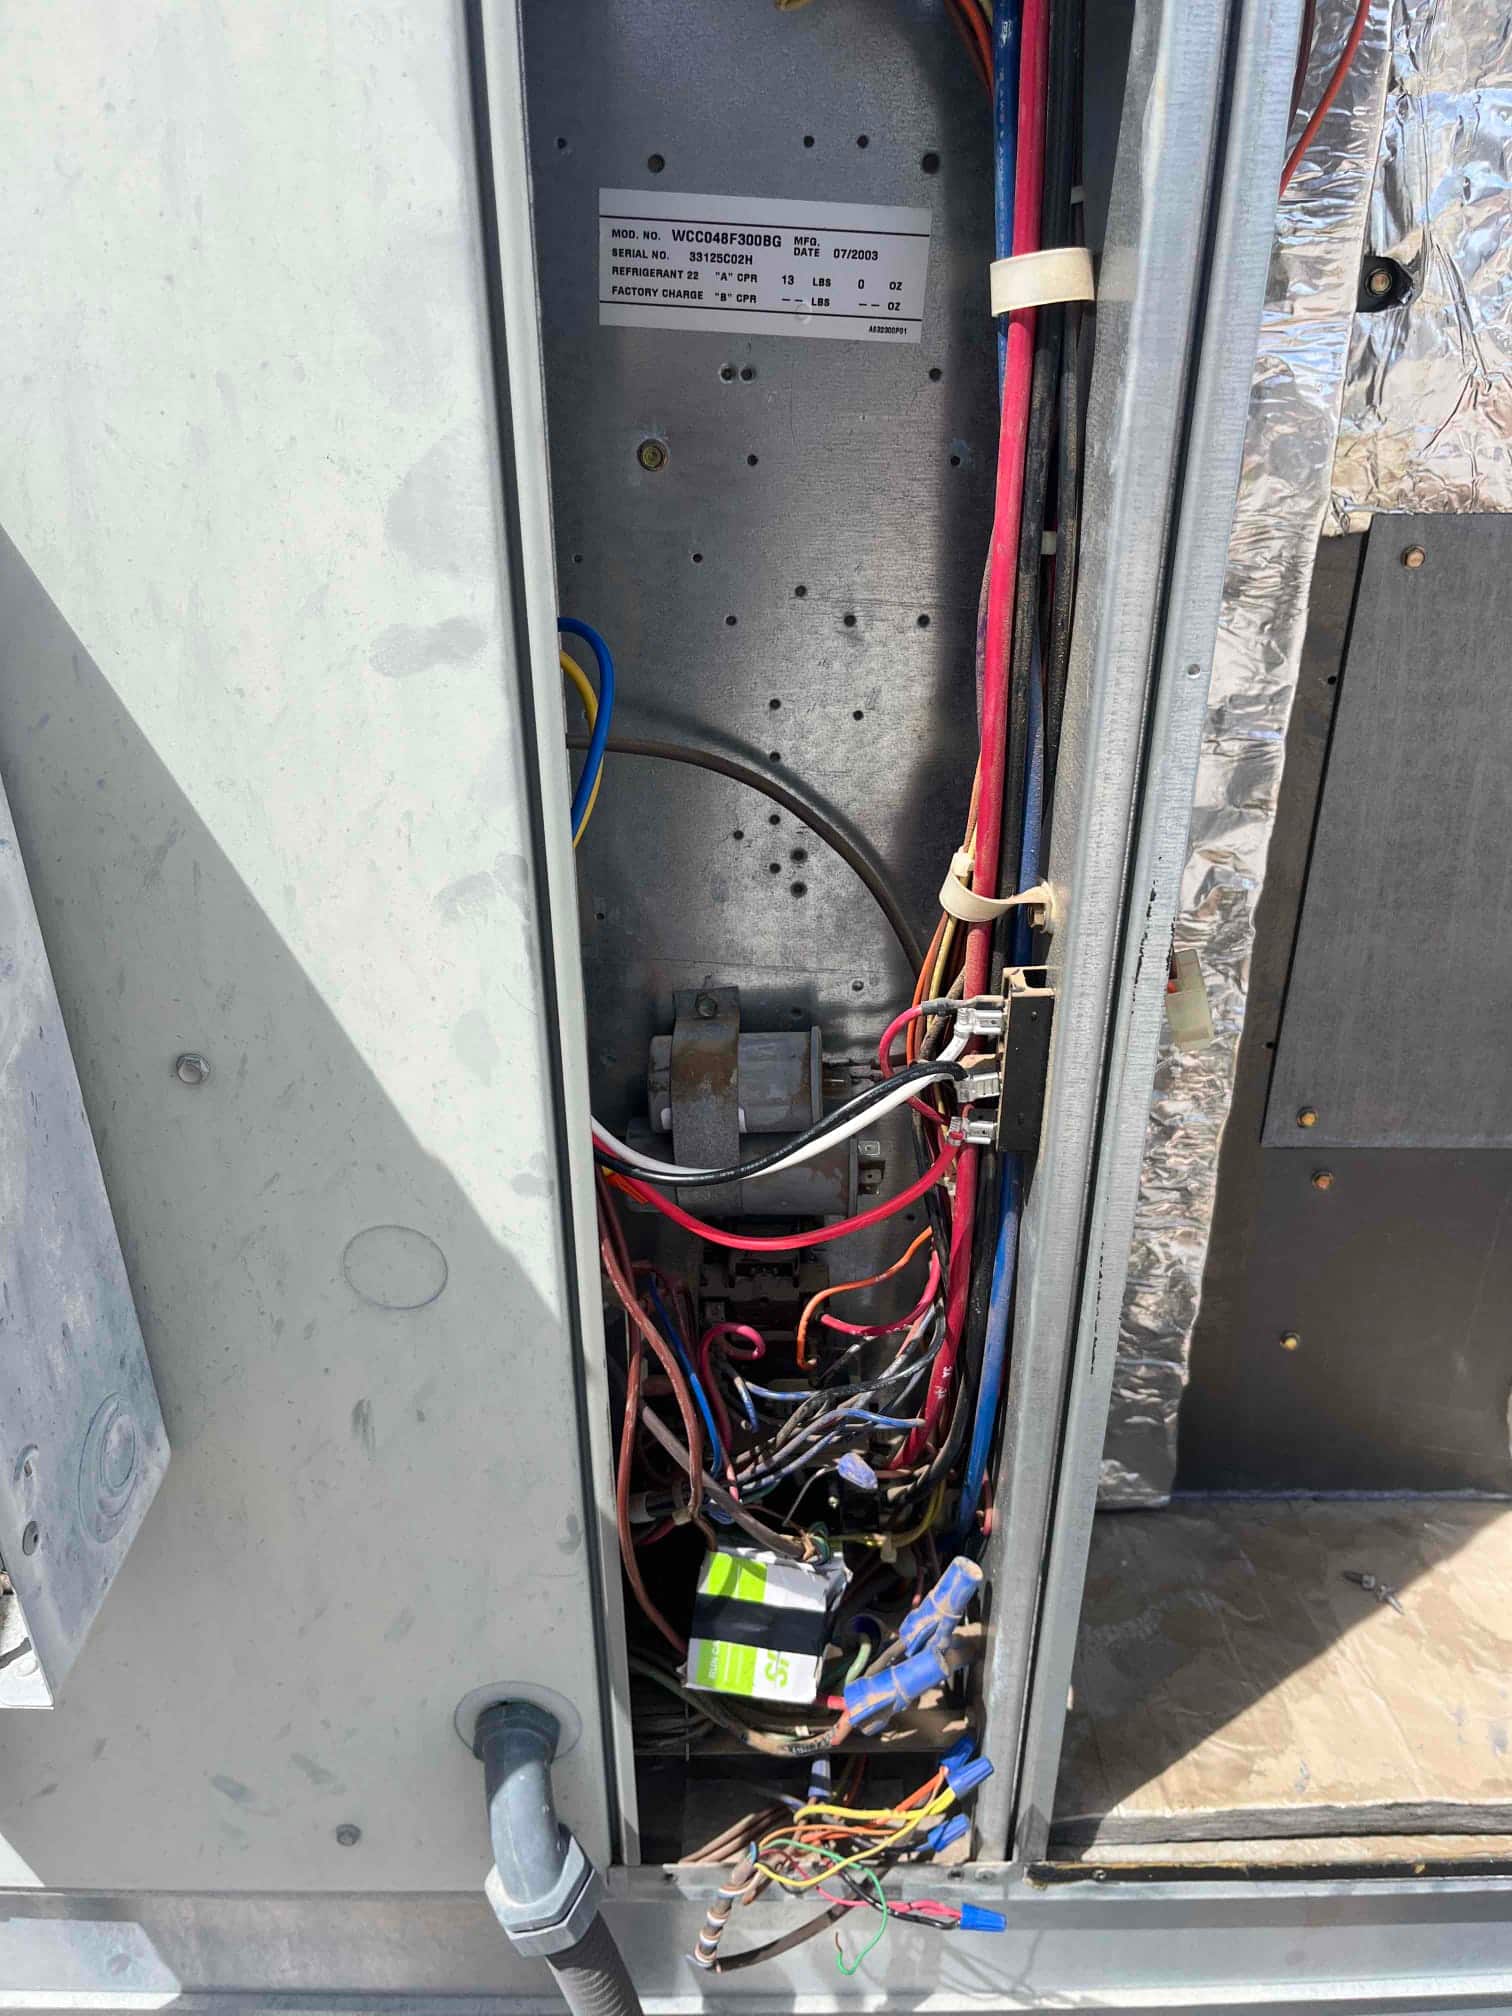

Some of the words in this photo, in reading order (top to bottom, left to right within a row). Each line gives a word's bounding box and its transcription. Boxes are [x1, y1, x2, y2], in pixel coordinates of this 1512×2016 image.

[612, 229, 639, 240] MOD.
[643, 231, 661, 241] NO.
[672, 229, 782, 248] WCC048F300BG
[794, 236, 820, 247] MFG.
[612, 248, 648, 259] SERIAL
[652, 250, 670, 261] NO.
[689, 251, 753, 265] 33125C02H
[793, 247, 820, 257] DATE
[833, 248, 879, 261] 07/2003
[612, 266, 684, 280] REFRIGERANT
[687, 270, 699, 280] 22
[715, 271, 733, 282] "A"
[736, 273, 758, 284] CPR
[782, 274, 795, 286] 13
[812, 277, 832, 288] LBS
[889, 281, 903, 291] OZ
[612, 286, 659, 298] FACTORY
[662, 288, 704, 300] CHARGE
[736, 293, 757, 304] CPR
[811, 297, 831, 307] LBS
[887, 302, 901, 312] OZ
